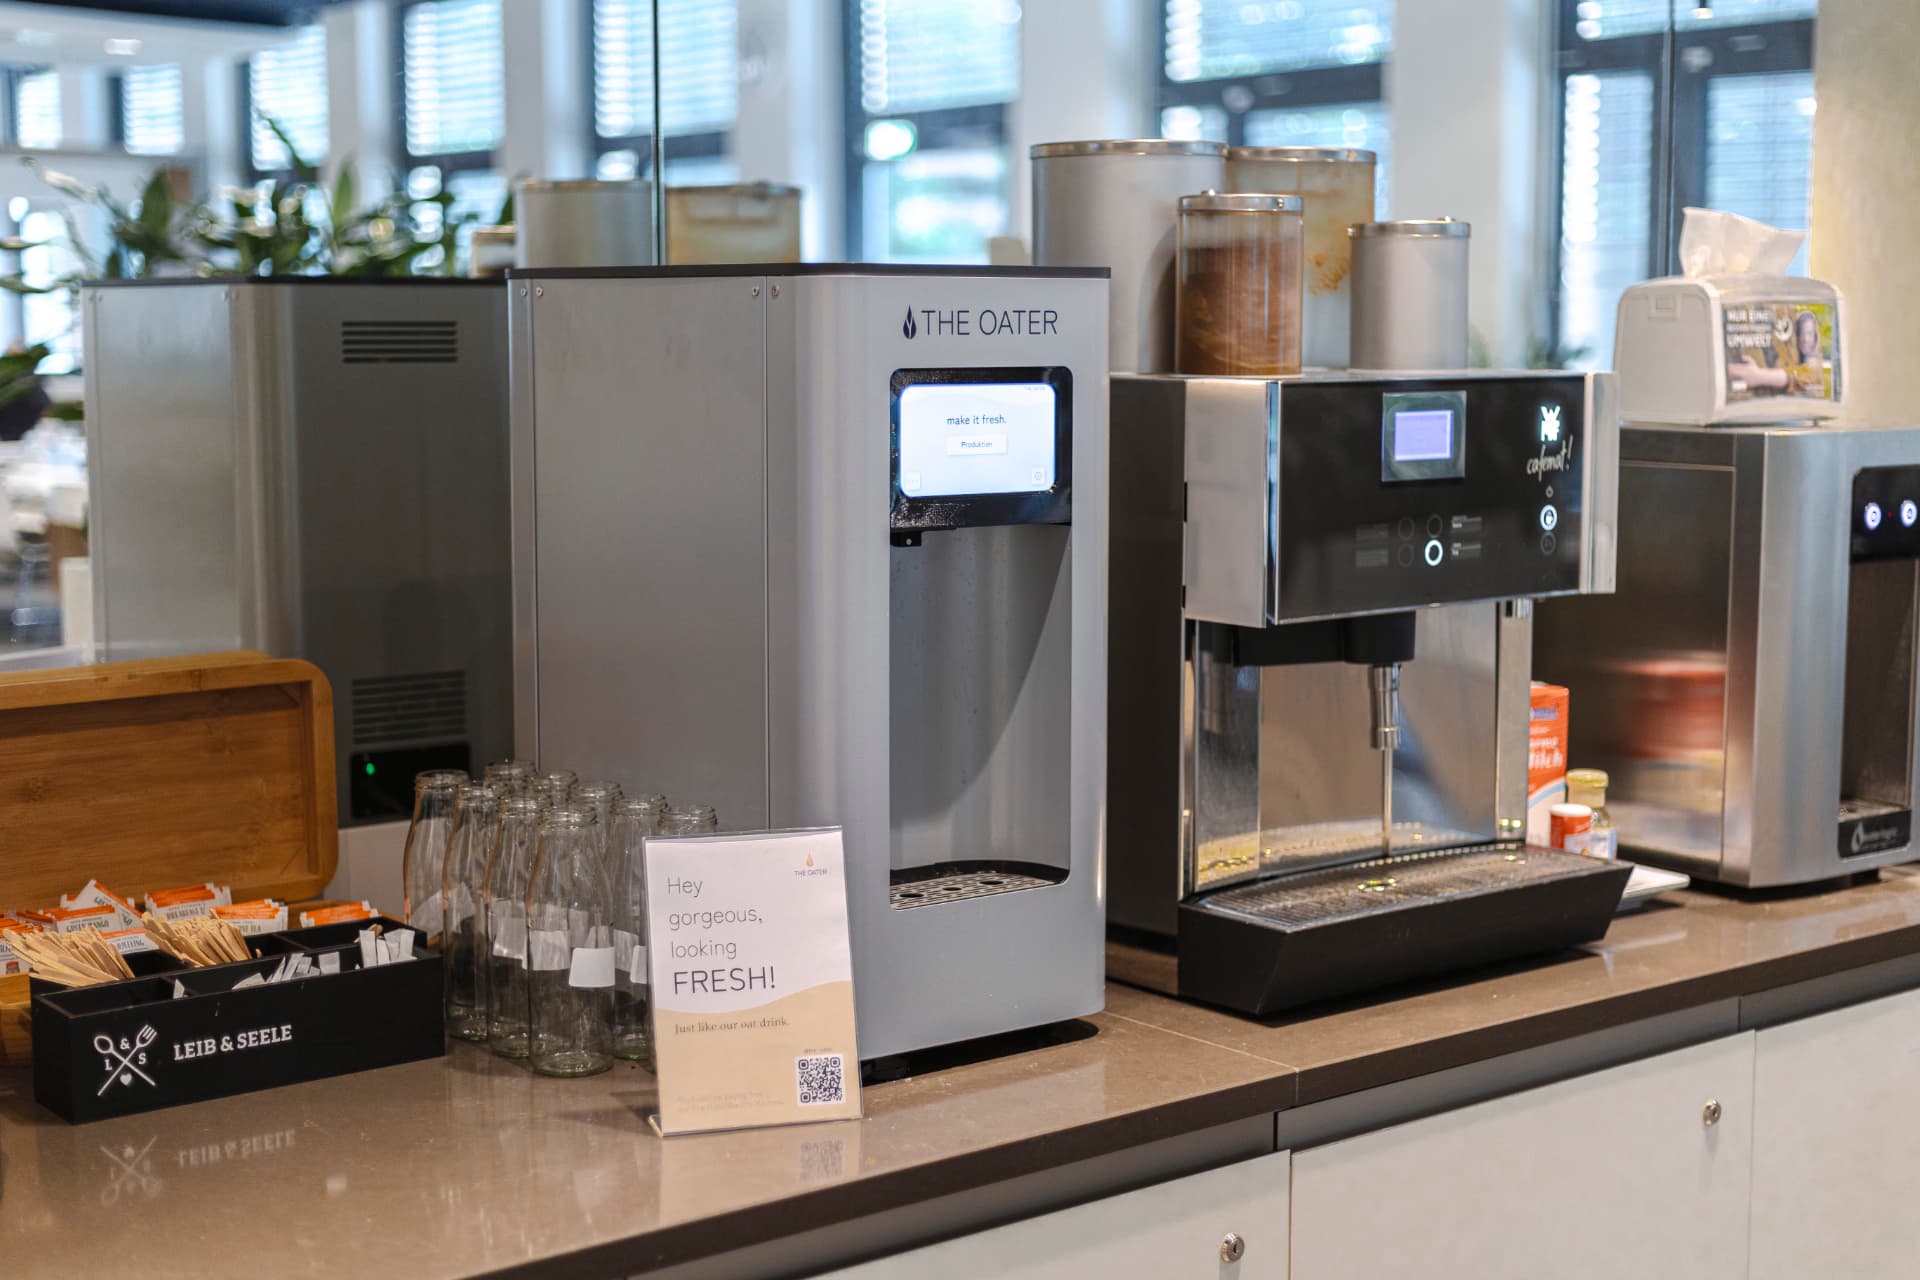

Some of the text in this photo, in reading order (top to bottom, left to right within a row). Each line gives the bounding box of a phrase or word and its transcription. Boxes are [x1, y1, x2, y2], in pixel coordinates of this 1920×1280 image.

[921, 309, 1059, 336] THE OATER
[947, 413, 1007, 426] make it fresh.
[961, 440, 993, 449] Produktion
[667, 876, 703, 898] Hey
[669, 906, 763, 931] gorgeous,
[671, 940, 737, 960] looking
[673, 965, 776, 996] FRESH!
[674, 1016, 790, 1035] Just like our oat drink.
[120, 1038, 130, 1050] &
[173, 1024, 293, 1062] LEIB & SEELE
[104, 1052, 147, 1071] L S
